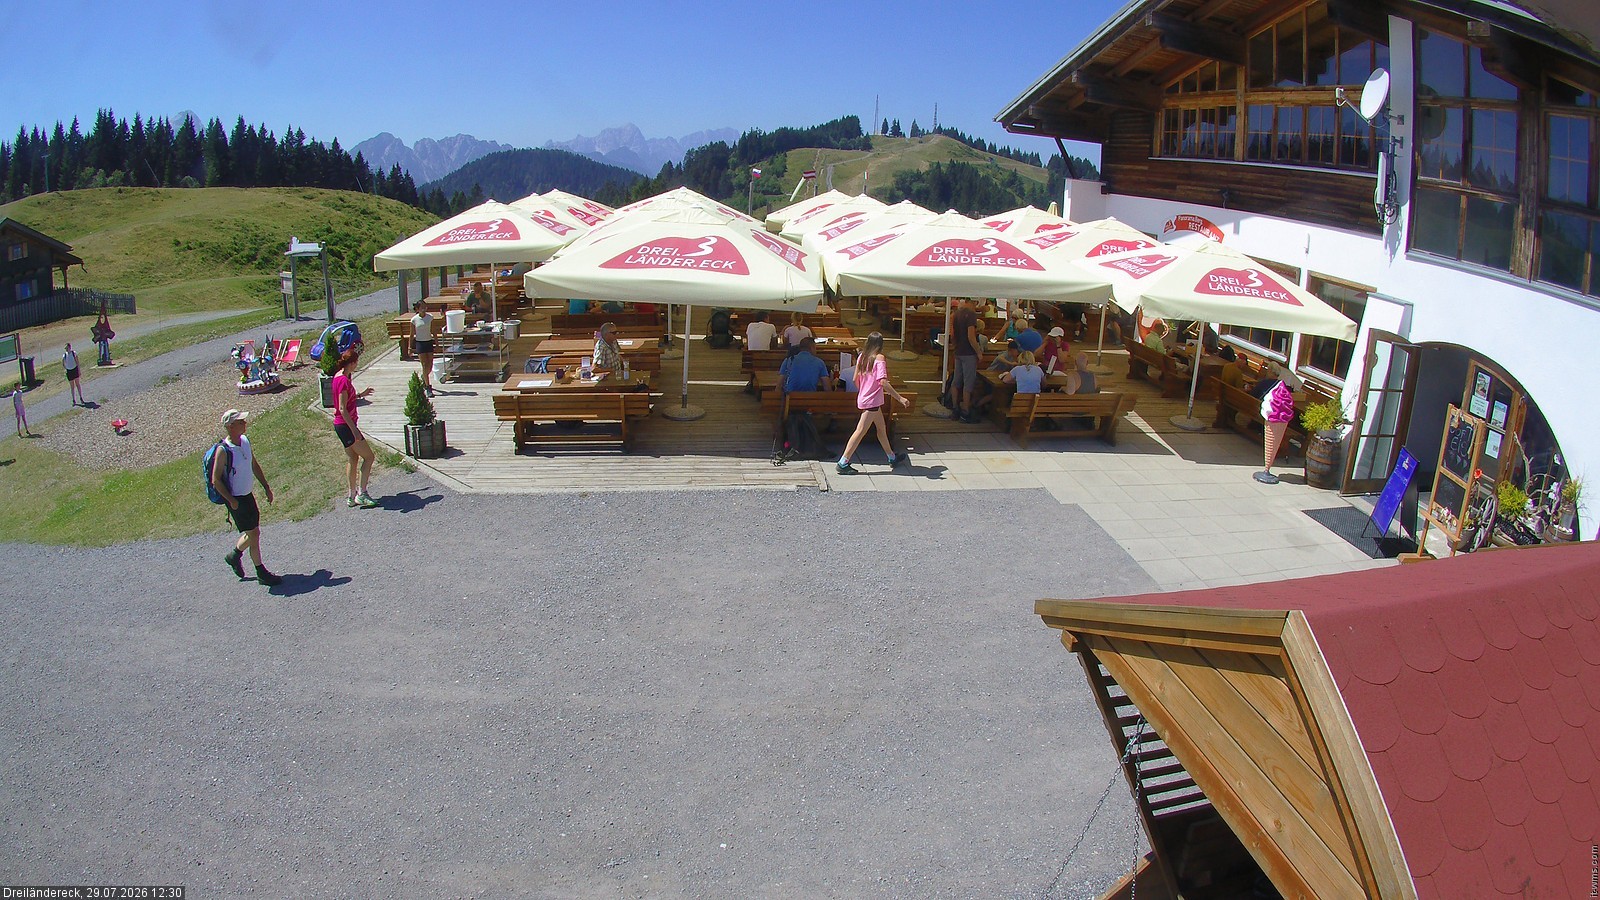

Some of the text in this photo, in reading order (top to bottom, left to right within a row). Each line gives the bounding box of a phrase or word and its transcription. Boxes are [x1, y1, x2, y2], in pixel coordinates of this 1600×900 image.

[439, 231, 513, 243] LÄNDER.ECK
[448, 228, 477, 236] DREI.
[637, 246, 681, 257] DREI.
[933, 246, 975, 256] DREI.
[624, 254, 737, 270] LÄNDER.ECK
[928, 253, 1028, 267] LÄNDER.ECK
[1209, 274, 1244, 287] DREI.
[1208, 282, 1288, 300] LÄNDER.ECK
